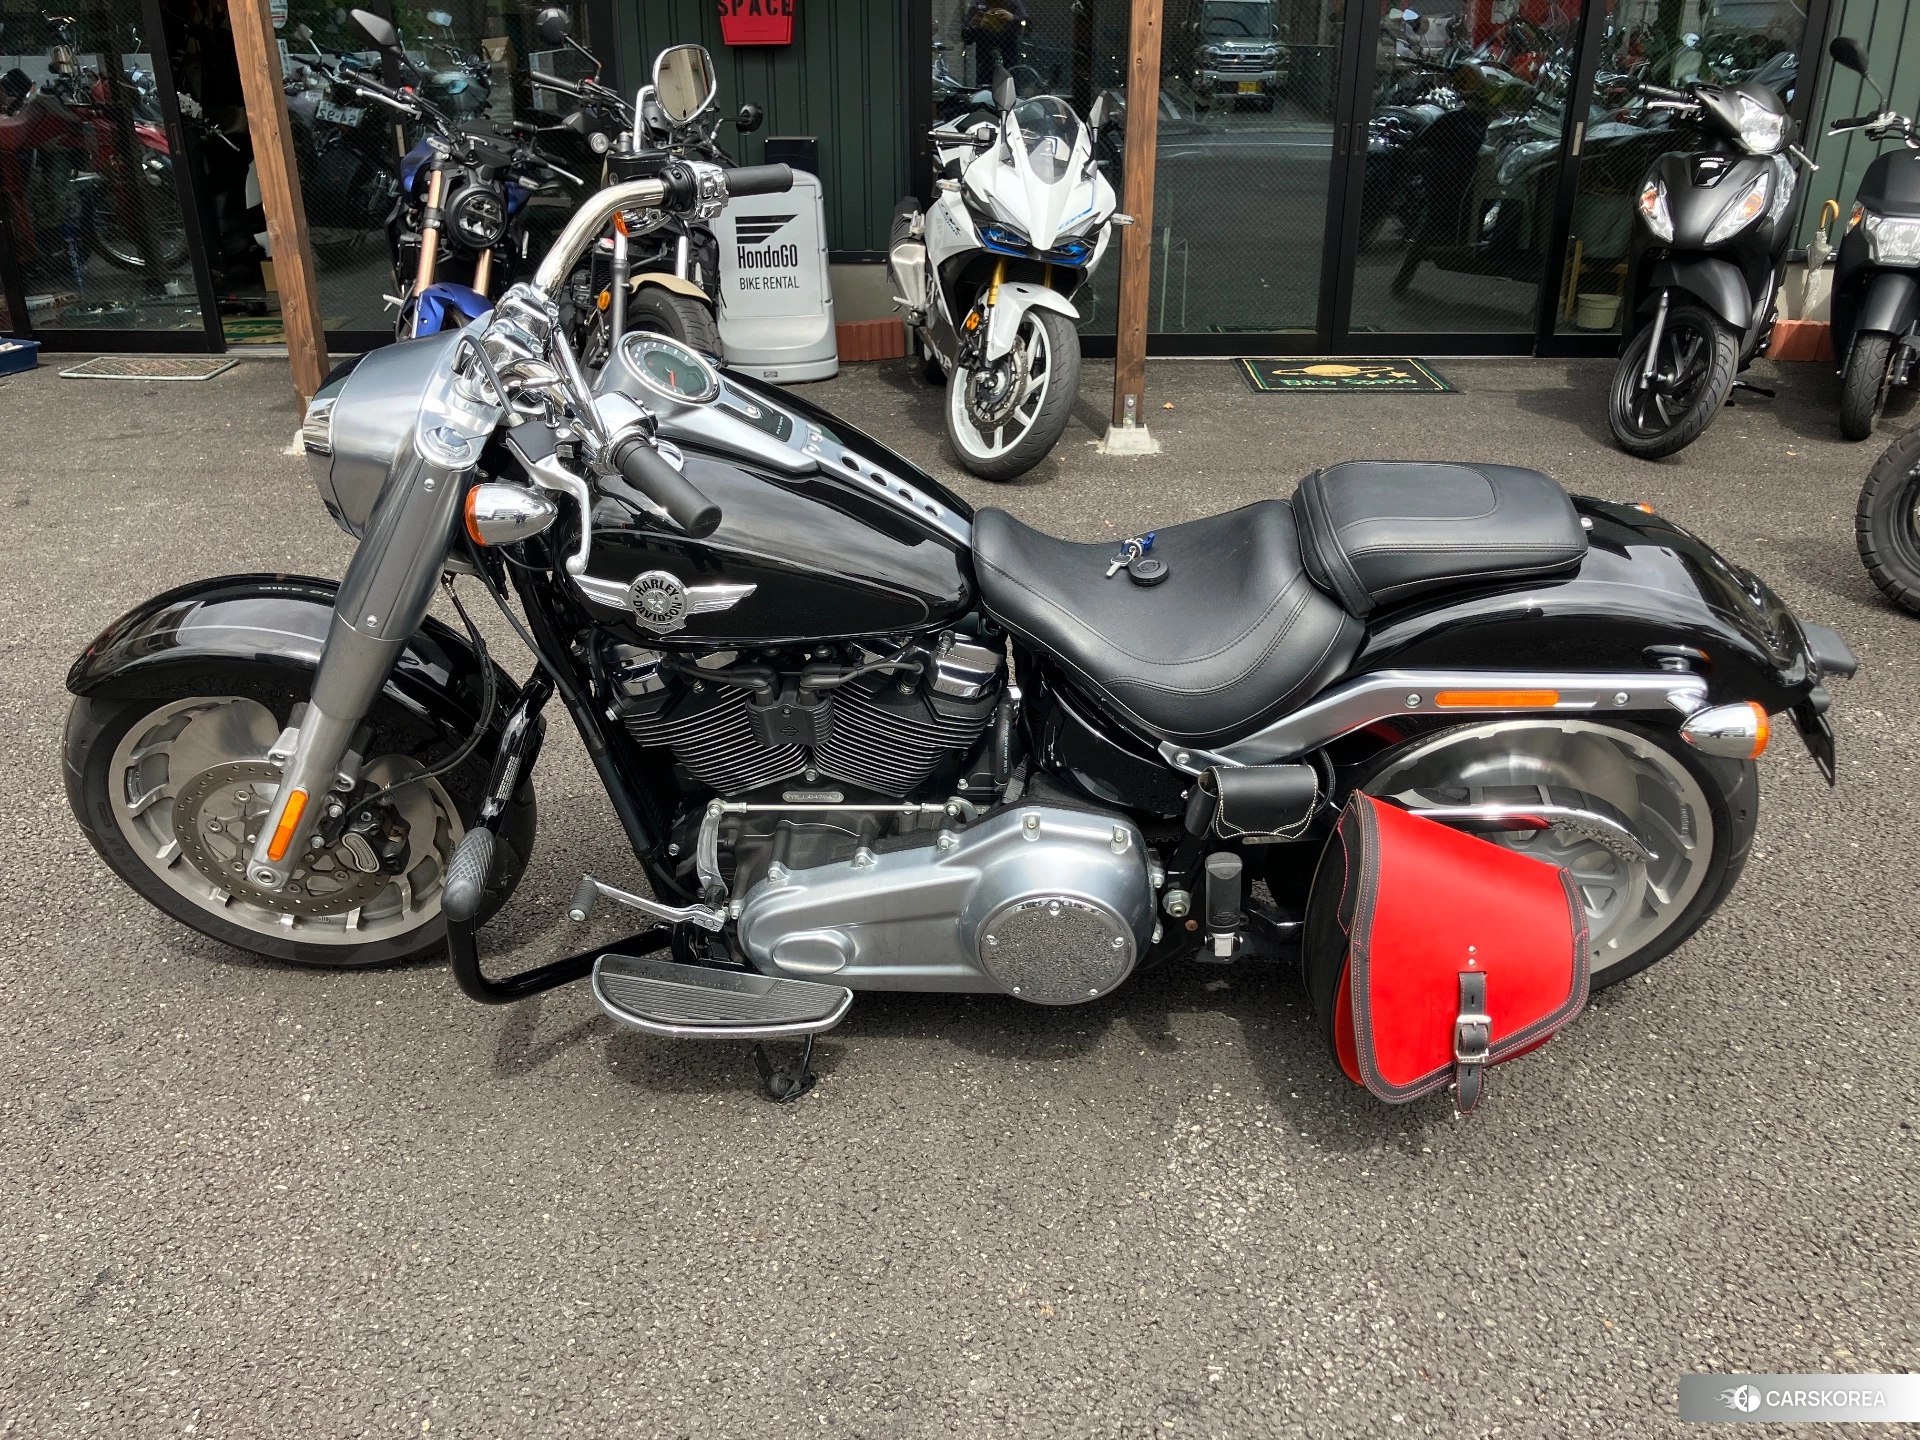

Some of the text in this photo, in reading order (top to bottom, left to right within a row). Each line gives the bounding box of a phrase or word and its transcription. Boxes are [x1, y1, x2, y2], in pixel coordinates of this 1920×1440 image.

[717, 0, 793, 16] SPACE
[737, 244, 798, 269] HondaGO
[740, 276, 800, 290] BIKE RENTAL
[635, 579, 679, 597] HARLEY
[633, 600, 682, 622] DAVIDSON
